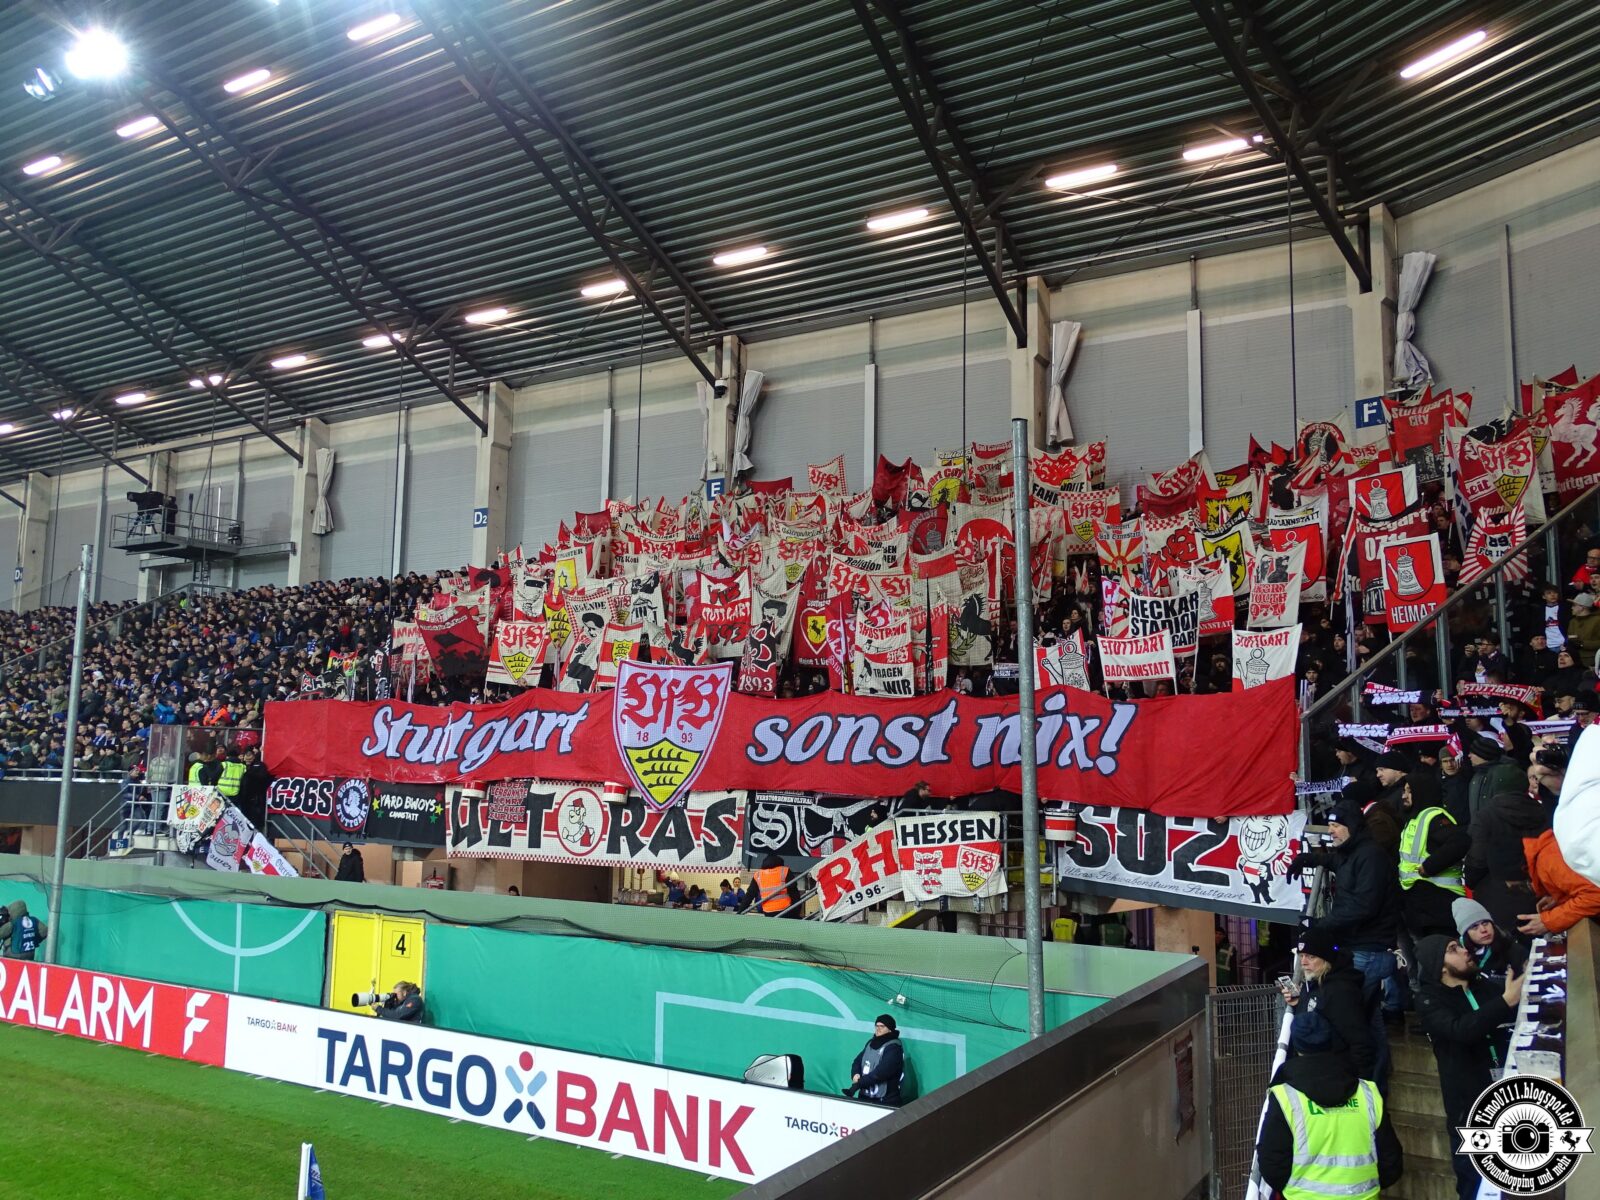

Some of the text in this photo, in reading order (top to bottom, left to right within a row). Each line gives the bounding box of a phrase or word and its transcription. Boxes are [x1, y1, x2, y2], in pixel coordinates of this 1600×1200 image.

[1131, 590, 1199, 619] NECKAR
[1101, 634, 1165, 656] STUTTGART
[873, 666, 903, 678] TRAGEN
[883, 679, 913, 696] WIR
[361, 692, 1139, 777] Stuttgart sonst nix!
[637, 730, 693, 744] 18 93
[380, 793, 404, 811] YARD
[900, 818, 996, 847] HESSEN
[816, 829, 899, 910] RH
[395, 934, 406, 955] 4
